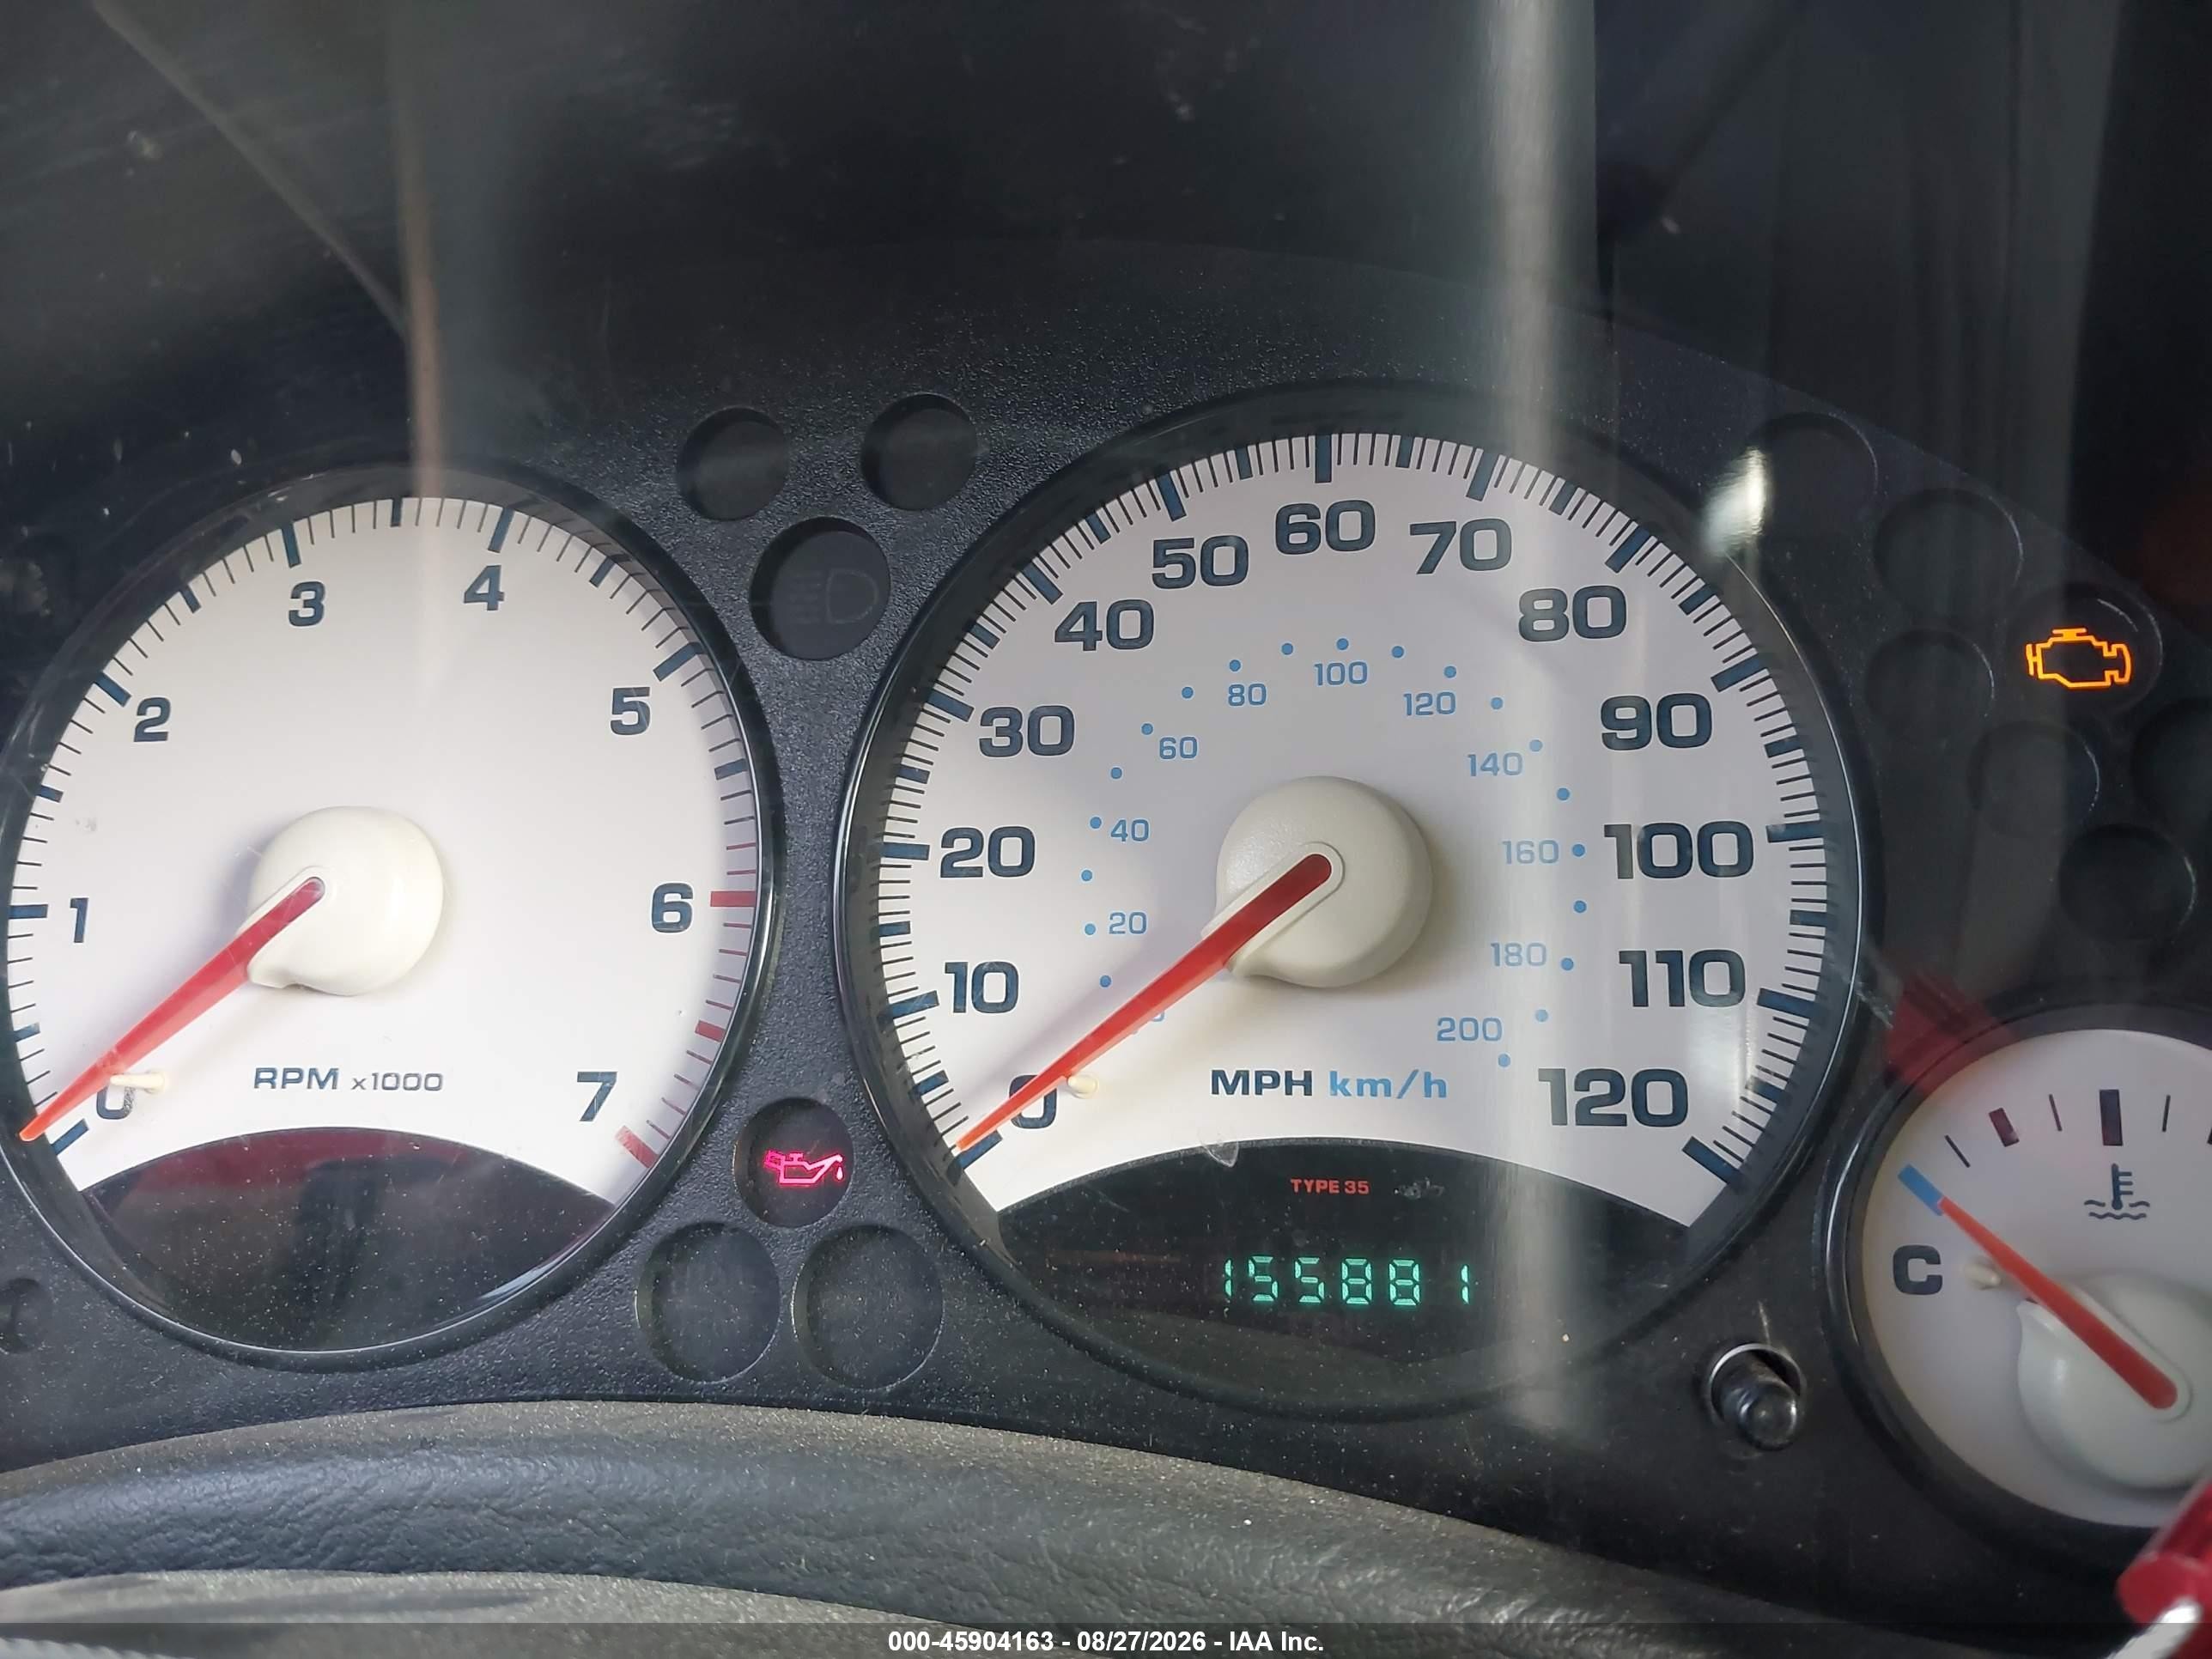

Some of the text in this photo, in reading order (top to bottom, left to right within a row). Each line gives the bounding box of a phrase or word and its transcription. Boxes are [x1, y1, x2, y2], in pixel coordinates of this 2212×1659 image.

[1274, 500, 1376, 554] 60
[1409, 517, 1512, 575] 70
[1152, 535, 1249, 589] 50
[288, 580, 326, 626] 3
[463, 564, 504, 611] 4
[1054, 599, 1154, 651] 40
[1517, 585, 1627, 642] 80
[1226, 684, 1267, 707] 80
[1314, 661, 1368, 685] 100
[133, 697, 172, 743] 2
[610, 687, 653, 736] 5
[1403, 691, 1457, 716] 120
[1600, 692, 1713, 750] 90
[978, 705, 1075, 757] 30
[1158, 736, 1199, 760] 60
[1467, 752, 1523, 777] 140
[939, 826, 1036, 878] 20
[1109, 818, 1150, 842] 40
[1502, 839, 1559, 865] 160
[1603, 820, 1754, 879] 100
[70, 896, 88, 944] 1
[651, 883, 693, 933] 6
[1109, 912, 1147, 935] 20
[1490, 942, 1547, 967] 180
[1619, 949, 1746, 1007] 110
[944, 961, 1019, 1014] 10
[1437, 1017, 1503, 1042] 200
[253, 1066, 444, 1092] RPM x1000
[576, 1072, 617, 1122] 7
[1009, 1075, 1057, 1129] 0
[1211, 1069, 1448, 1099] MPH km/h
[1538, 1068, 1689, 1127] 120
[1291, 1178, 1370, 1194] TYPE 35
[1224, 1255, 1471, 1306] 155881
[1893, 1244, 1942, 1295] C
